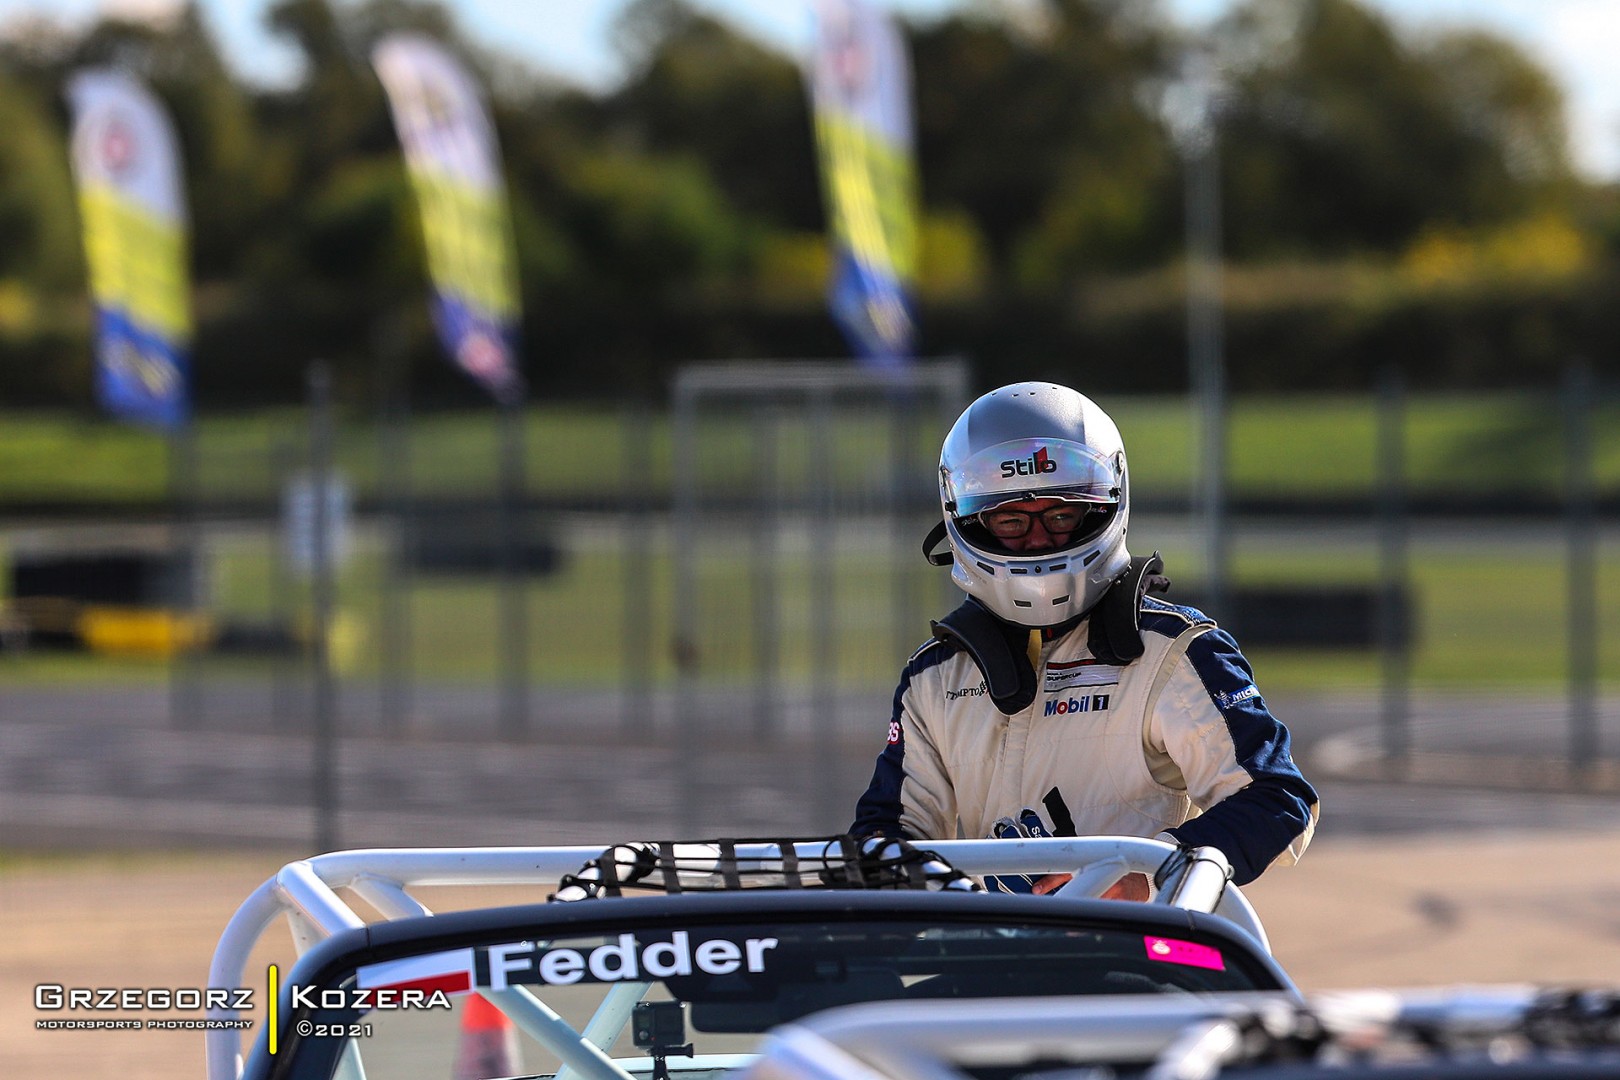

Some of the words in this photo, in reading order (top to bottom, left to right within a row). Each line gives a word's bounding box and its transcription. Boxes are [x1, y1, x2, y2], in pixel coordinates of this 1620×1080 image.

[1000, 447, 1057, 478] Stilo
[1044, 696, 1090, 717] Mobil
[488, 931, 778, 992] Fedder
